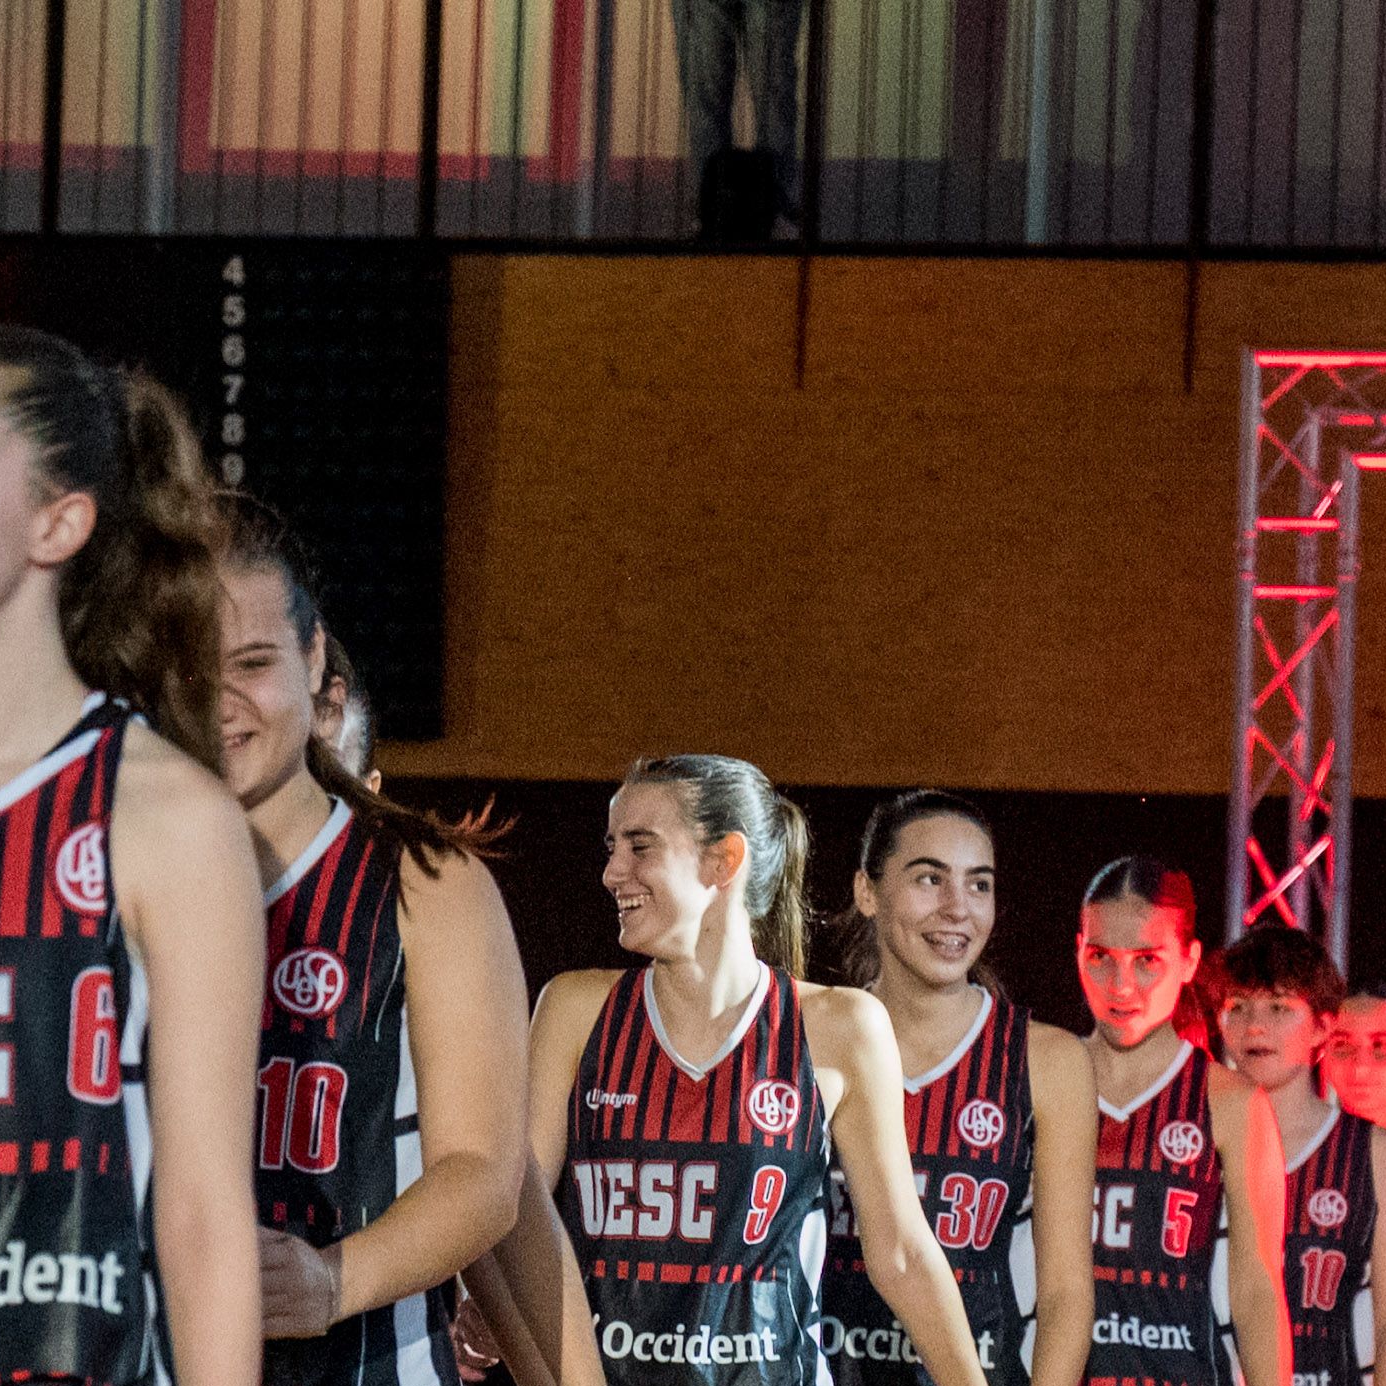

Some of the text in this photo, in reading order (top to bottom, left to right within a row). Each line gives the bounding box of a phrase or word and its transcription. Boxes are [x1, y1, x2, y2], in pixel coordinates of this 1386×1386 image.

[221, 254, 245, 285] 4
[221, 295, 245, 326] 5
[221, 335, 245, 365] 6
[221, 375, 244, 405] 7
[221, 414, 245, 445] 8
[67, 964, 120, 1105] 6
[258, 1057, 347, 1175] 10
[573, 1161, 719, 1242] UESC
[742, 1164, 788, 1245] 9
[935, 1172, 1010, 1251] 30
[1161, 1187, 1200, 1258] 5
[1300, 1246, 1347, 1311] 10
[602, 1321, 781, 1366] Occident
